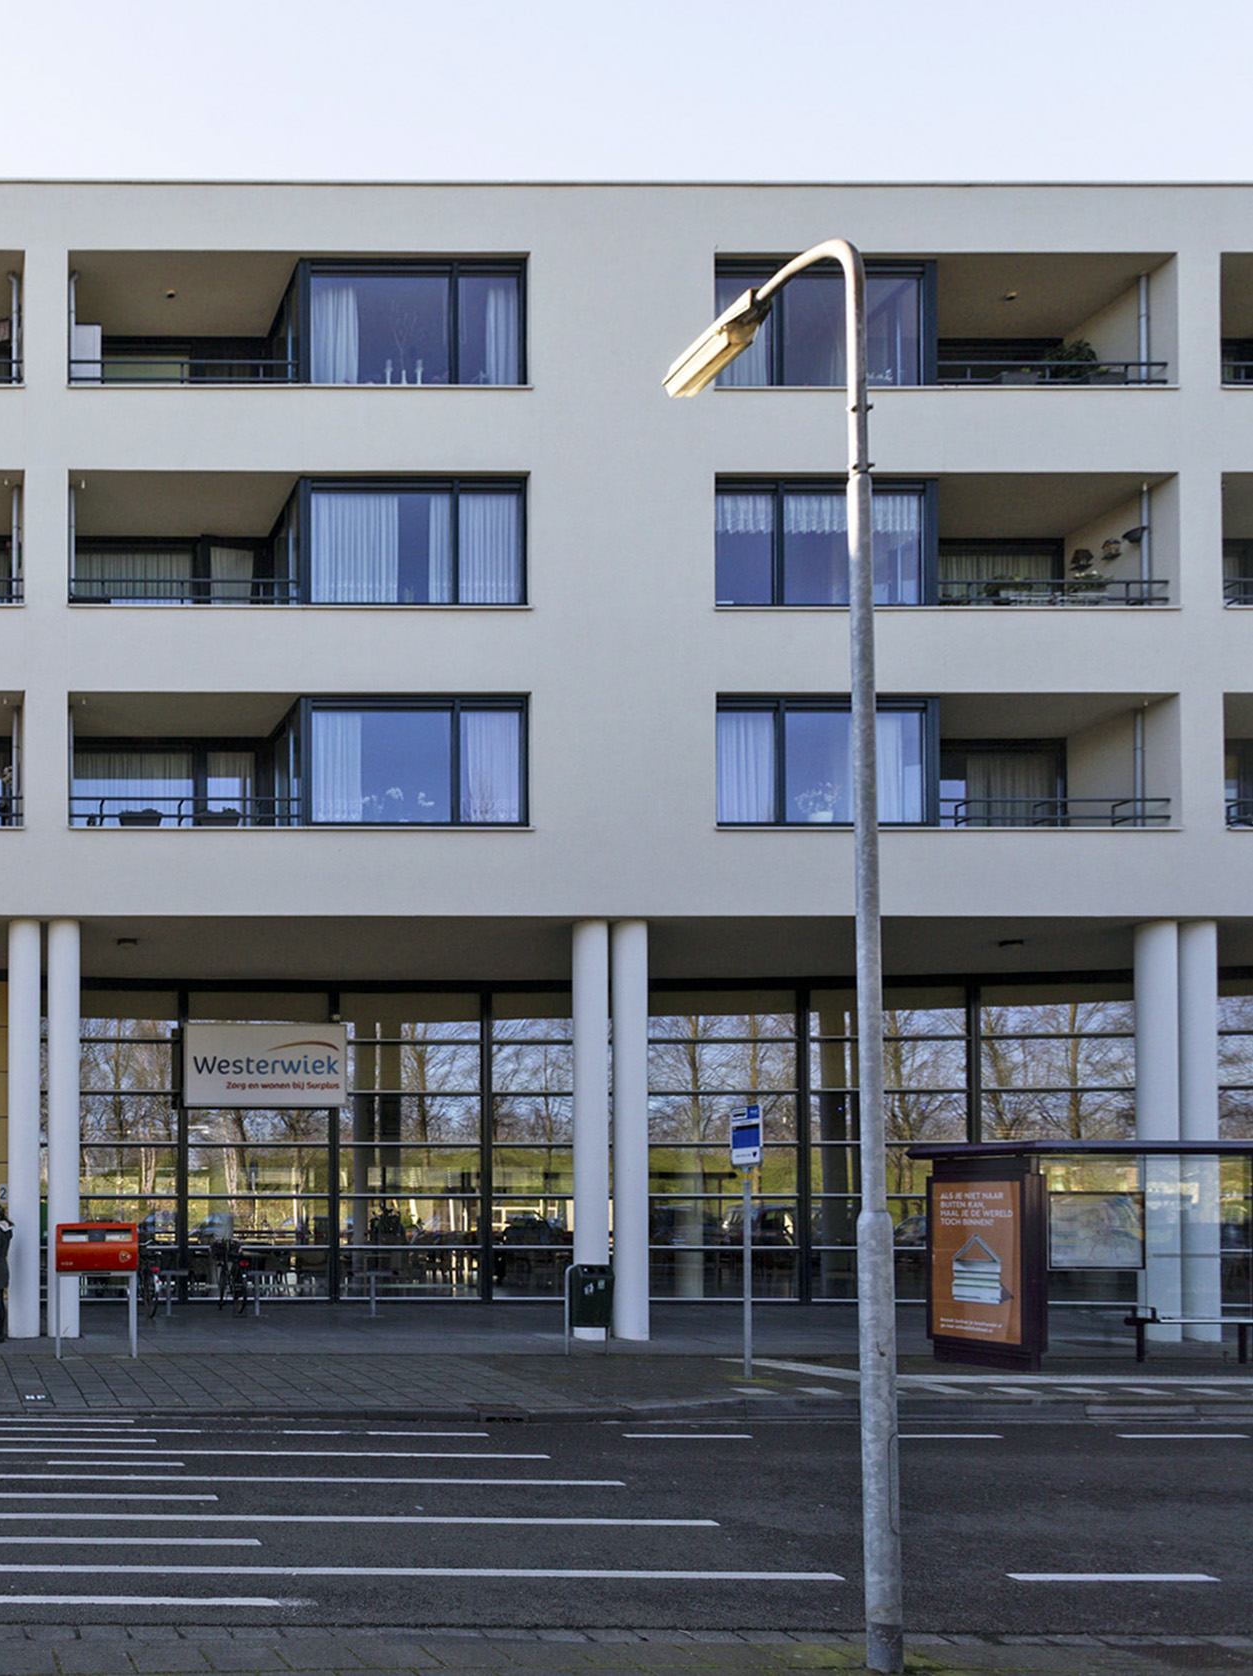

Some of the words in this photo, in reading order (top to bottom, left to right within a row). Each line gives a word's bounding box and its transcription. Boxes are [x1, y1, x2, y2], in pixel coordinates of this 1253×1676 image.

[193, 1055, 339, 1075] Westerwiek
[226, 1081, 246, 1090] Zorg
[292, 1081, 305, 1090] bij
[307, 1081, 340, 1090] Surplus
[0, 1187, 7, 1200] 2
[940, 1192, 954, 1200] ALS
[955, 1192, 962, 1200] JE
[964, 1192, 980, 1200] NIET
[982, 1192, 1004, 1200] NAAR
[940, 1209, 959, 1217] HAAL
[961, 1209, 969, 1217] JE
[971, 1209, 980, 1217] DE
[983, 1209, 1014, 1218] WERELD
[940, 1218, 961, 1226] TOCH
